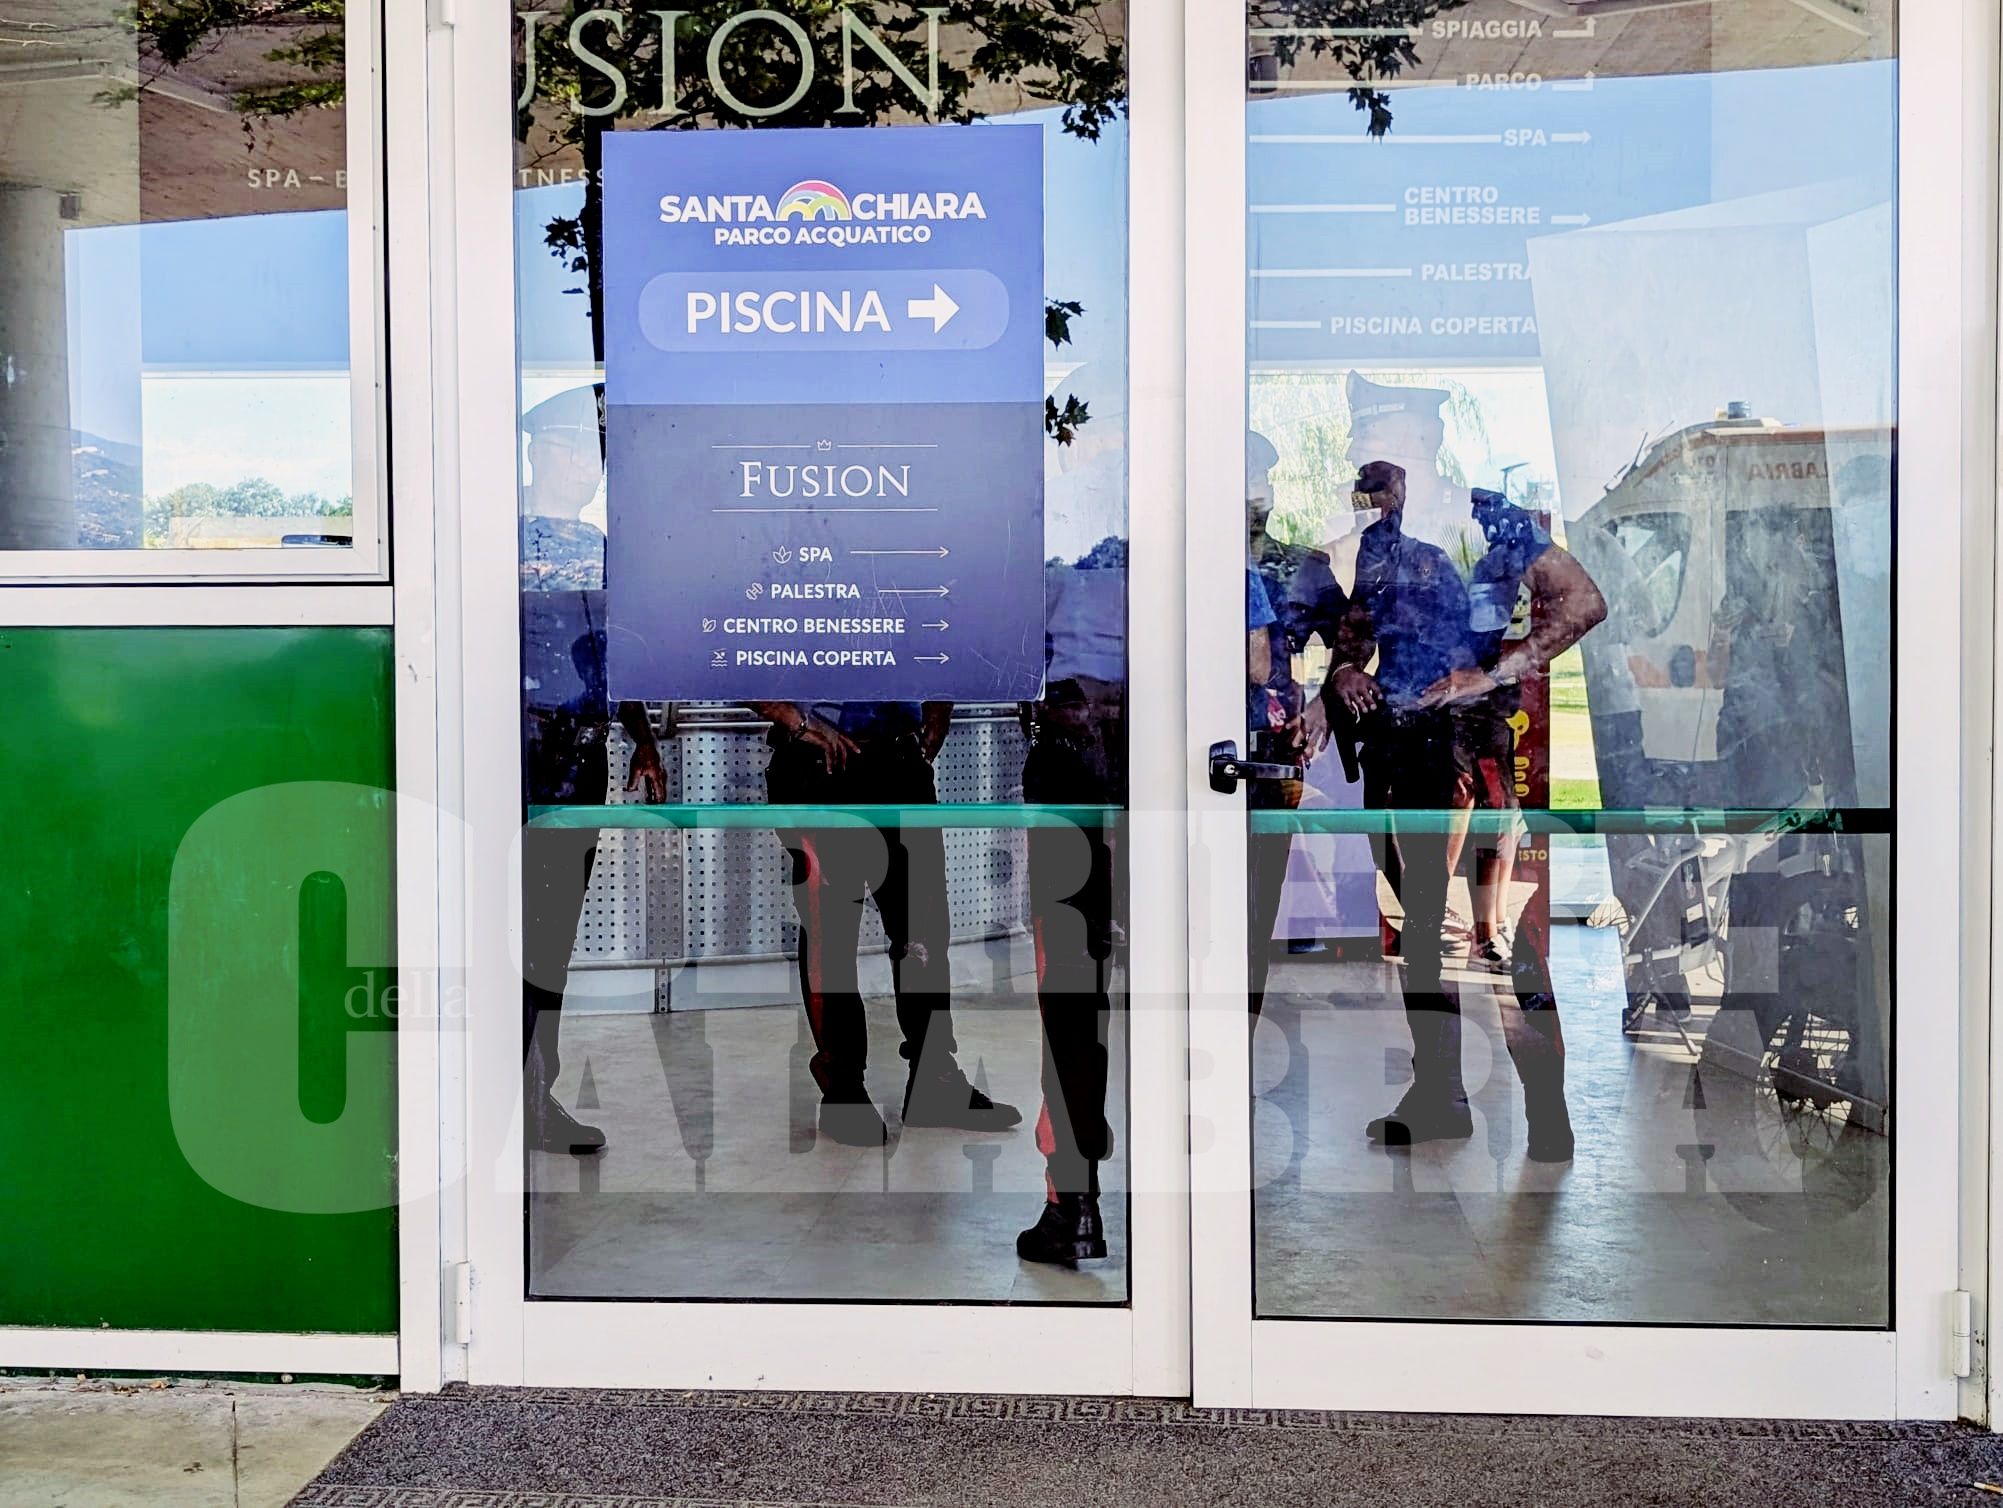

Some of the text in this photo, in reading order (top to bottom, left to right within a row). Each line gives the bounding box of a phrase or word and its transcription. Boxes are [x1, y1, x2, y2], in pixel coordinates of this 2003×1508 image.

[1432, 20, 1542, 39] SPIAGGIA
[1466, 73, 1542, 91] PARCO
[1504, 129, 1547, 147] SPA
[247, 168, 301, 188] SPA
[1404, 187, 1499, 204] CENTRO
[659, 192, 987, 223] SANTA CHIARA
[1404, 207, 1541, 225] BENESSERE
[714, 225, 931, 248] PARCO ACQUATICO
[686, 290, 892, 334] PISCINA
[1330, 316, 1537, 334] PISCINA COPERTA
[798, 546, 833, 562] SPA
[770, 583, 861, 600] PALESTRA
[723, 618, 905, 634] CENTRO BENESSERE
[736, 650, 897, 666] PISCINA COPERTA
[1518, 849, 1548, 861] STO
